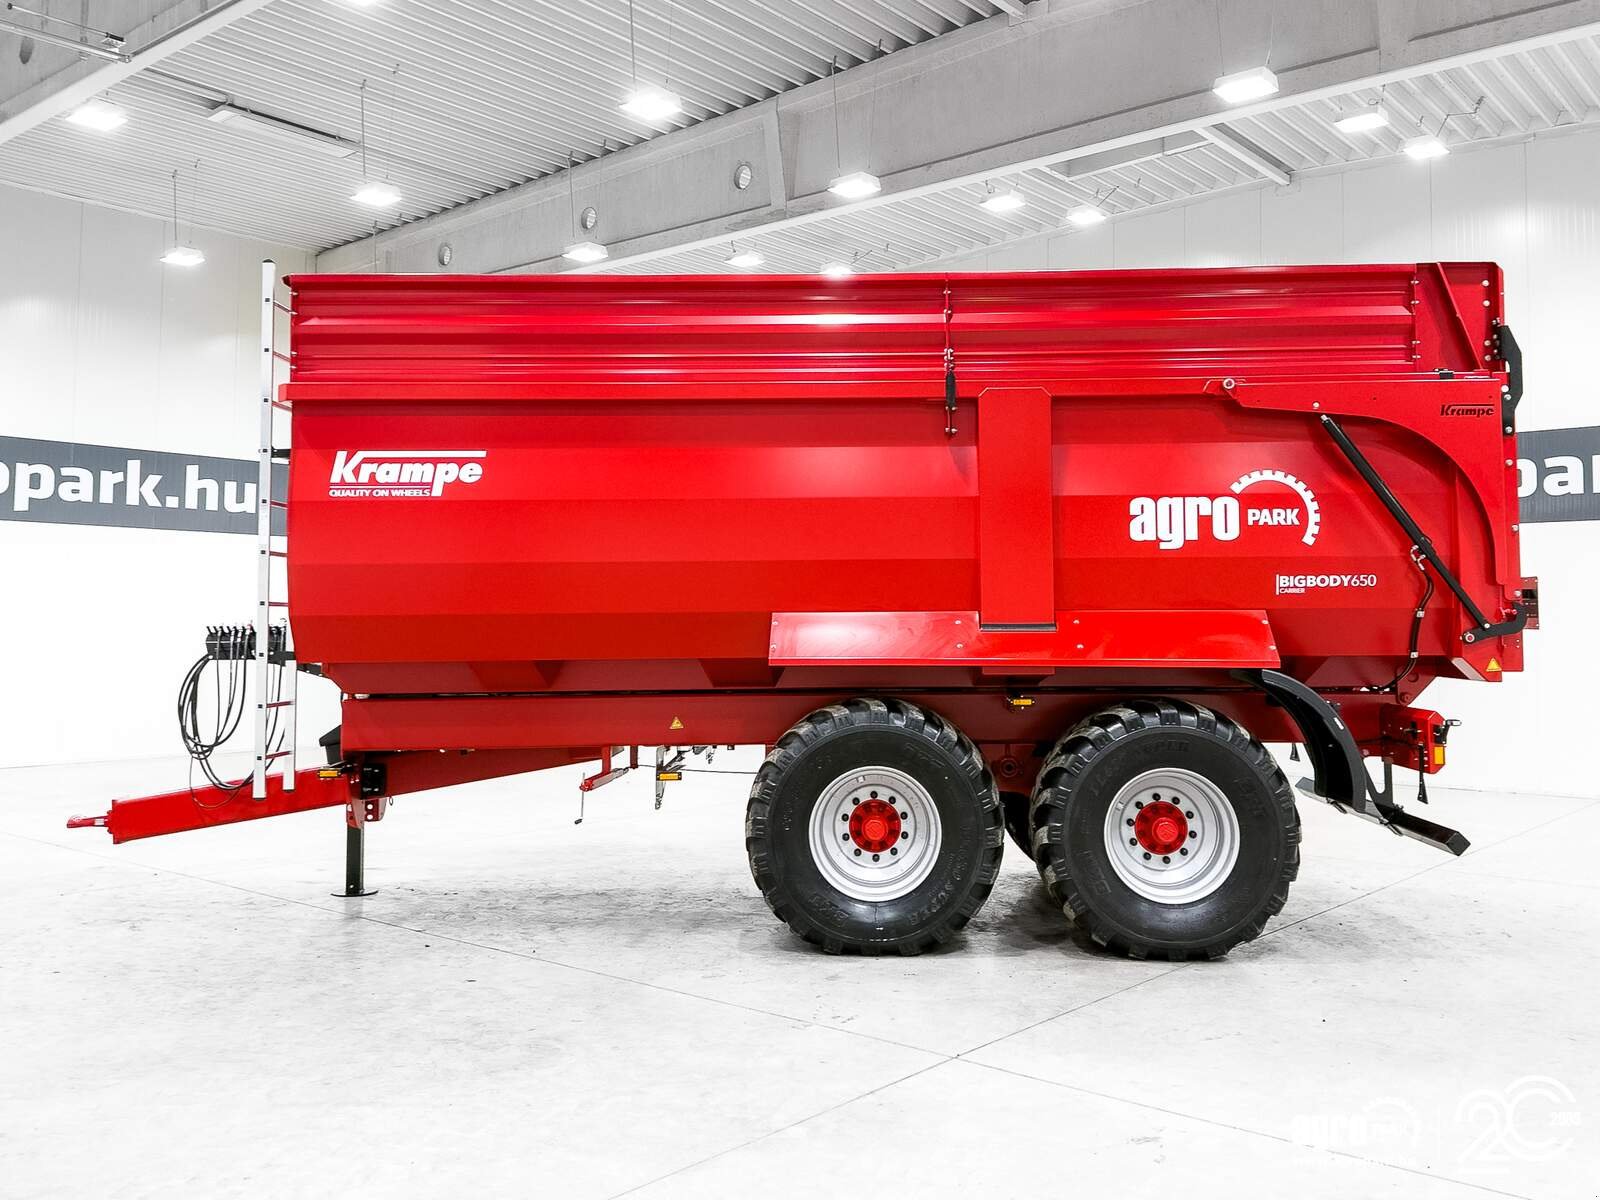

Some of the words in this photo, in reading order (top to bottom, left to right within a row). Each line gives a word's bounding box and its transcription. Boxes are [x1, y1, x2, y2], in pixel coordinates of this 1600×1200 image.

[1440, 403, 1495, 418] Krampe
[0, 459, 257, 513] park.hu
[330, 450, 487, 497] Krampe
[329, 488, 371, 497] QUALITY
[372, 488, 388, 497] ON
[391, 488, 431, 497] WHEELS
[1129, 496, 1240, 550] agro
[1247, 508, 1300, 526] PARK
[1279, 574, 1378, 588] BIGBODY650
